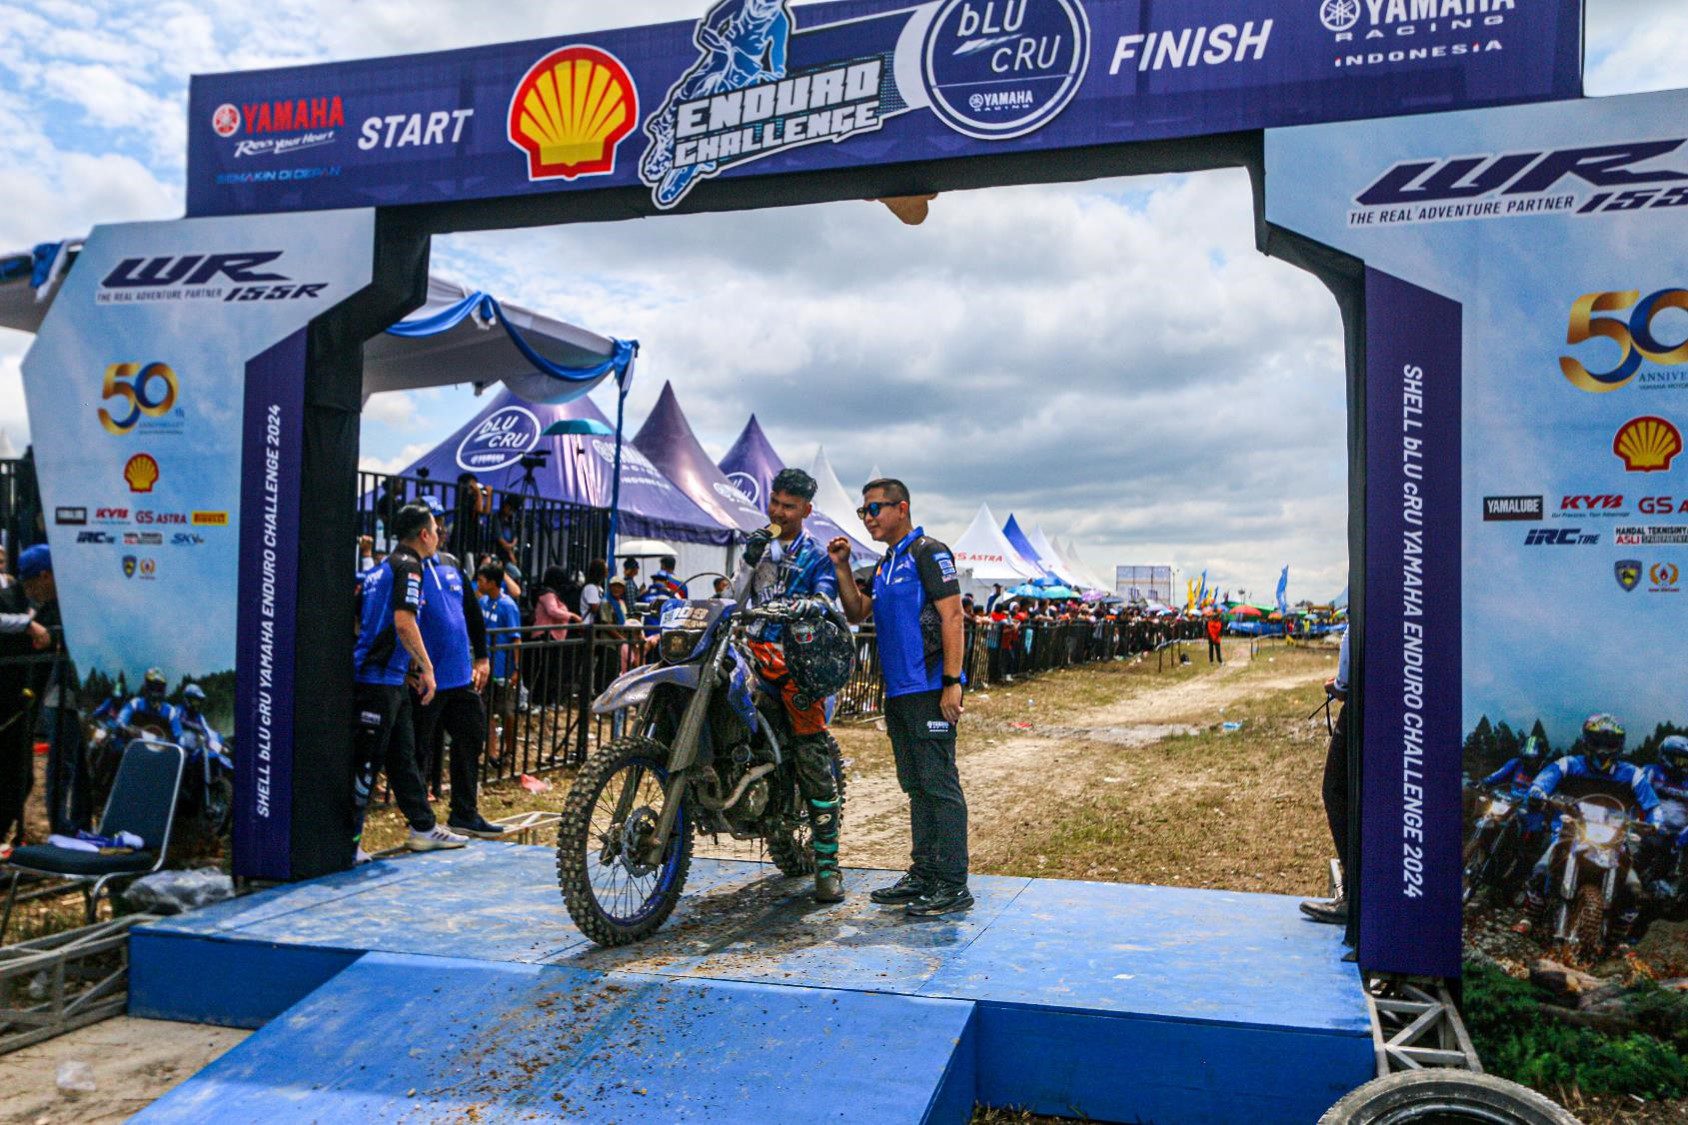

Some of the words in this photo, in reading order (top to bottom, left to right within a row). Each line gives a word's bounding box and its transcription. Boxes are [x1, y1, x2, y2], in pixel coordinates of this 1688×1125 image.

[957, 0, 1028, 36] bLU
[1335, 15, 1504, 42] RACING
[1366, 0, 1515, 25] YAM
[991, 35, 1061, 72] cRU
[1109, 19, 1274, 75] FINISH
[242, 96, 345, 134] YAMAHA
[676, 60, 881, 139] ENDURO
[984, 90, 1033, 106] YAMAHA
[358, 109, 474, 150] START
[674, 100, 880, 168] CHALLENGE
[1356, 138, 1688, 206] WR
[1350, 211, 1376, 225] THE
[1380, 208, 1413, 222] REAL
[1419, 200, 1500, 219] ADVENTURE
[1507, 195, 1575, 213] PARTNER
[101, 251, 293, 288] WR
[97, 293, 111, 302] THE
[113, 292, 132, 301] REAL
[136, 290, 181, 300] ADVENTURE
[184, 288, 222, 298] PARTNER
[224, 283, 329, 302] 155R
[97, 362, 180, 435] 50
[1403, 364, 1423, 432] SHELL
[266, 404, 281, 447] 2024
[1403, 436, 1423, 480] bLU
[136, 511, 154, 524] GS
[157, 513, 187, 525] ASTRA
[263, 447, 280, 548] CHALLENGE
[1403, 482, 1423, 526] cRU
[1487, 498, 1540, 513] YAMALUBE
[1561, 495, 1624, 510] KYB
[1638, 496, 1674, 514] GS
[1616, 535, 1640, 545] ASLI
[261, 550, 277, 618] ENDURO
[1403, 531, 1423, 616] YAMAHA
[260, 620, 275, 687] YAMAHA
[1403, 621, 1424, 710] ENDURO
[258, 693, 273, 727] cRU
[258, 729, 272, 762] bLU
[257, 764, 271, 818] SHELL
[1403, 713, 1424, 842] CHALLENGE
[1403, 843, 1424, 897] 2024
